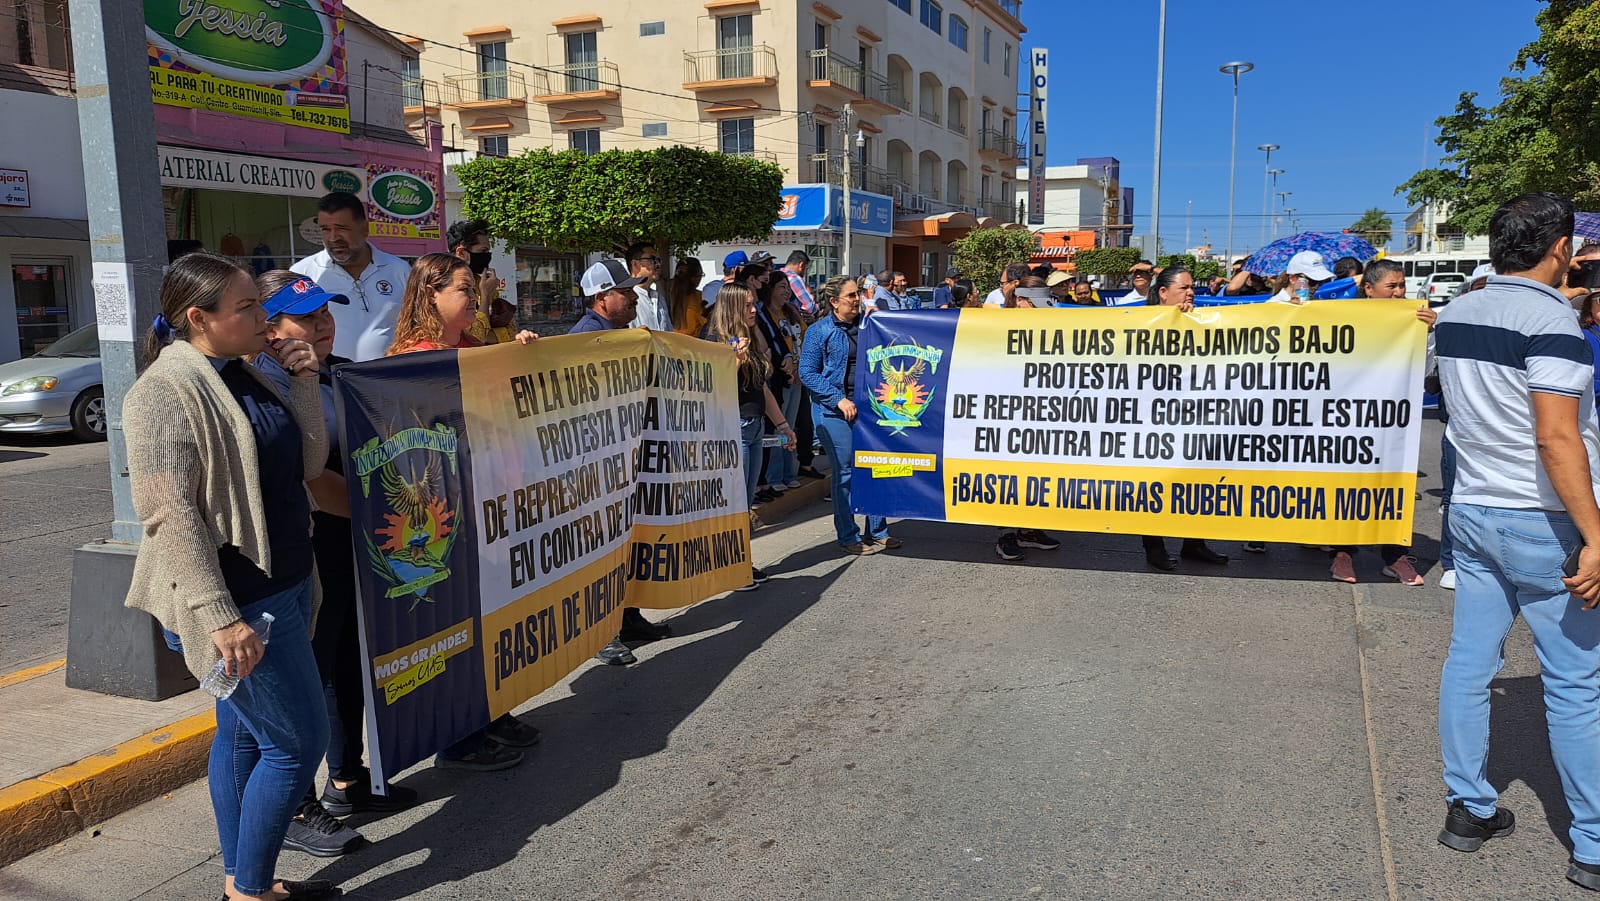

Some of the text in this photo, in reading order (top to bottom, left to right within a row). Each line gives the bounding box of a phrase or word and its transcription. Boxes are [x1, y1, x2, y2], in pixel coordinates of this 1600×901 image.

[167, 74, 197, 91] PARA
[200, 80, 214, 94] TU
[218, 83, 283, 106] CREATIVIDAD
[1034, 53, 1046, 157] HOTEL
[159, 155, 316, 190] ATERIAL CREATIVO
[375, 224, 408, 235] KIDS
[1007, 325, 1355, 356] EN LA UAS TRABAJAMOS BAJO
[509, 373, 539, 419] EN
[540, 369, 564, 413] LA
[564, 363, 600, 404] UAS
[687, 360, 713, 393] BAJO
[1023, 355, 1331, 391] PROTESTA POR LA POLÍTICA
[952, 390, 1411, 428] DE REPRESIÓN DEL GOBIERNO DEL ESTADO
[536, 408, 616, 467] PROTESTA
[974, 427, 1380, 465] EN CONTRA DE LOS UNIVERSITARIOS.
[857, 455, 931, 466] SOMOS GRANDES
[482, 494, 509, 545] DE
[513, 457, 601, 532] REPRESIÓN
[602, 452, 629, 493] DEL
[701, 439, 739, 471] ESTADO
[952, 472, 1404, 521] ¡BASTA DE MENTIRAS RUBÉN ROCHA MOYA!
[509, 539, 536, 589] EN
[540, 510, 605, 574] CONTRA
[605, 500, 623, 542] DE
[636, 477, 728, 516] NIVERSITARIOS.
[494, 528, 746, 691] ¡BASTA DE MENTIR UBÉN ROCHA MOYA!
[374, 629, 468, 680] MOS GRANDES
